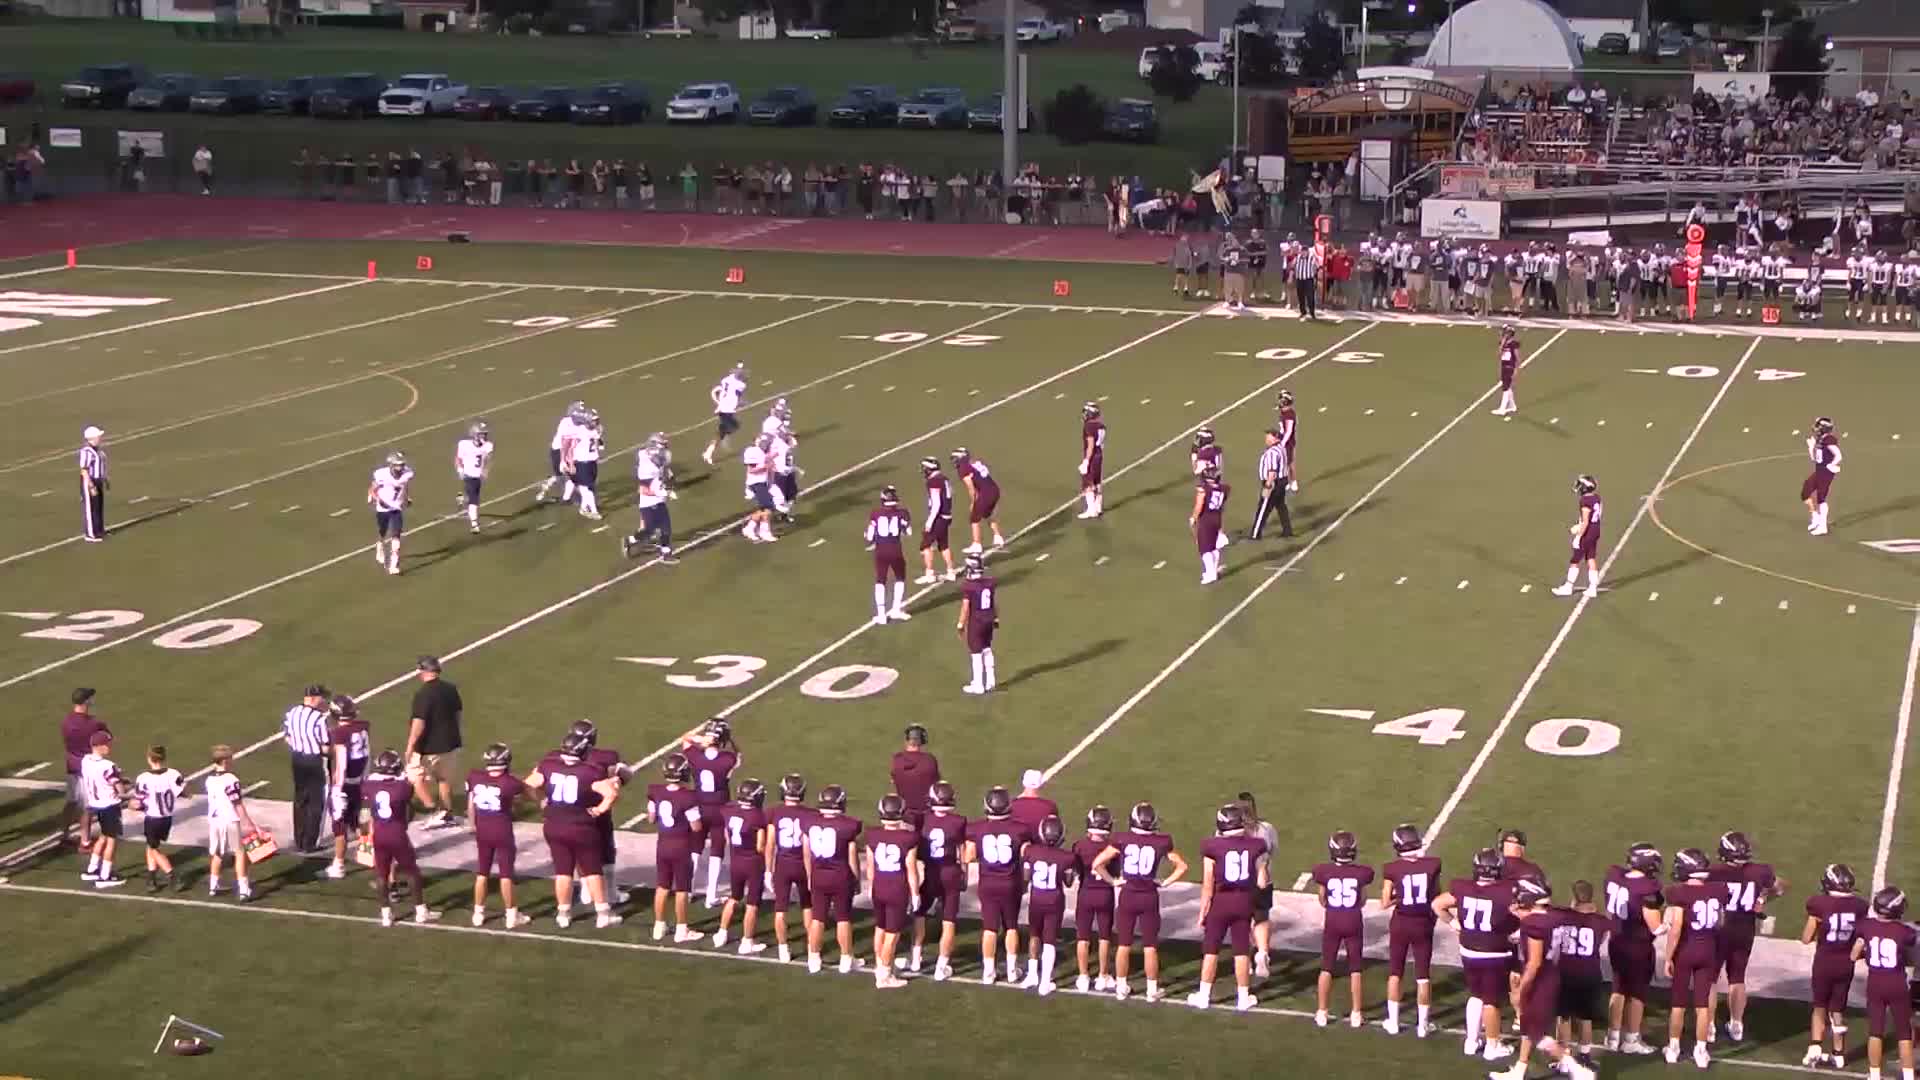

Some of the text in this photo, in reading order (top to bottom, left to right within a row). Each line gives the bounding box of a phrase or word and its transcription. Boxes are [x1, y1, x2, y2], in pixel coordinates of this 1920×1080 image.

[20, 610, 264, 649] 20
[665, 655, 899, 698] 30
[1372, 708, 1621, 756] 40
[155, 789, 175, 816] 10
[928, 827, 945, 858] 2
[1032, 860, 1057, 889] 21
[1123, 844, 1155, 875] 20
[1224, 850, 1249, 882] 61
[1326, 878, 1357, 908] 35
[1401, 873, 1428, 905] 17
[1726, 881, 1755, 911] 74
[1462, 896, 1493, 931] 77
[1826, 912, 1855, 941] 15
[1869, 936, 1898, 968] 19
